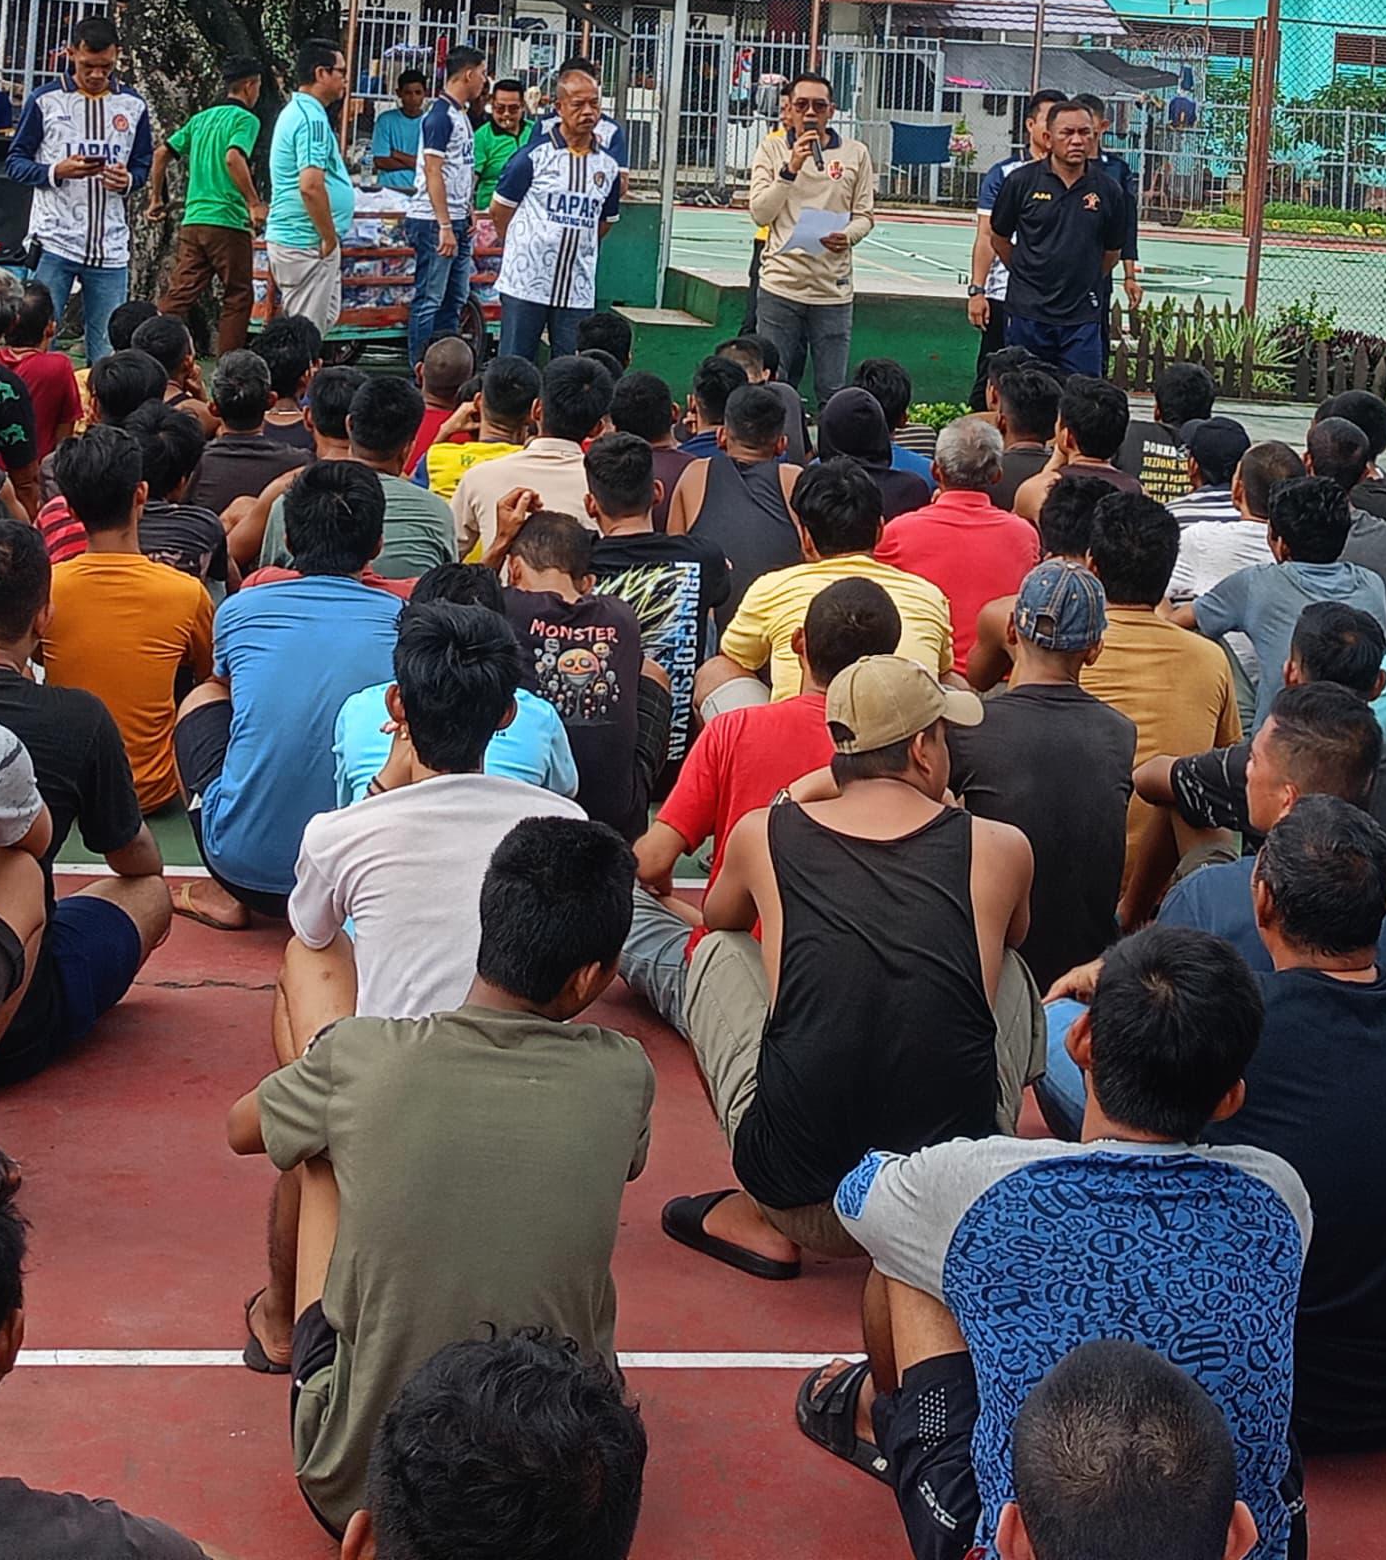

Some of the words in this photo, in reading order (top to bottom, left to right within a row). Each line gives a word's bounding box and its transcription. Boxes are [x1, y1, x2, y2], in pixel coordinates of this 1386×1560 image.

[693, 15, 704, 29] 7
[547, 193, 599, 218] LAPAS
[530, 618, 619, 643] MONSTER
